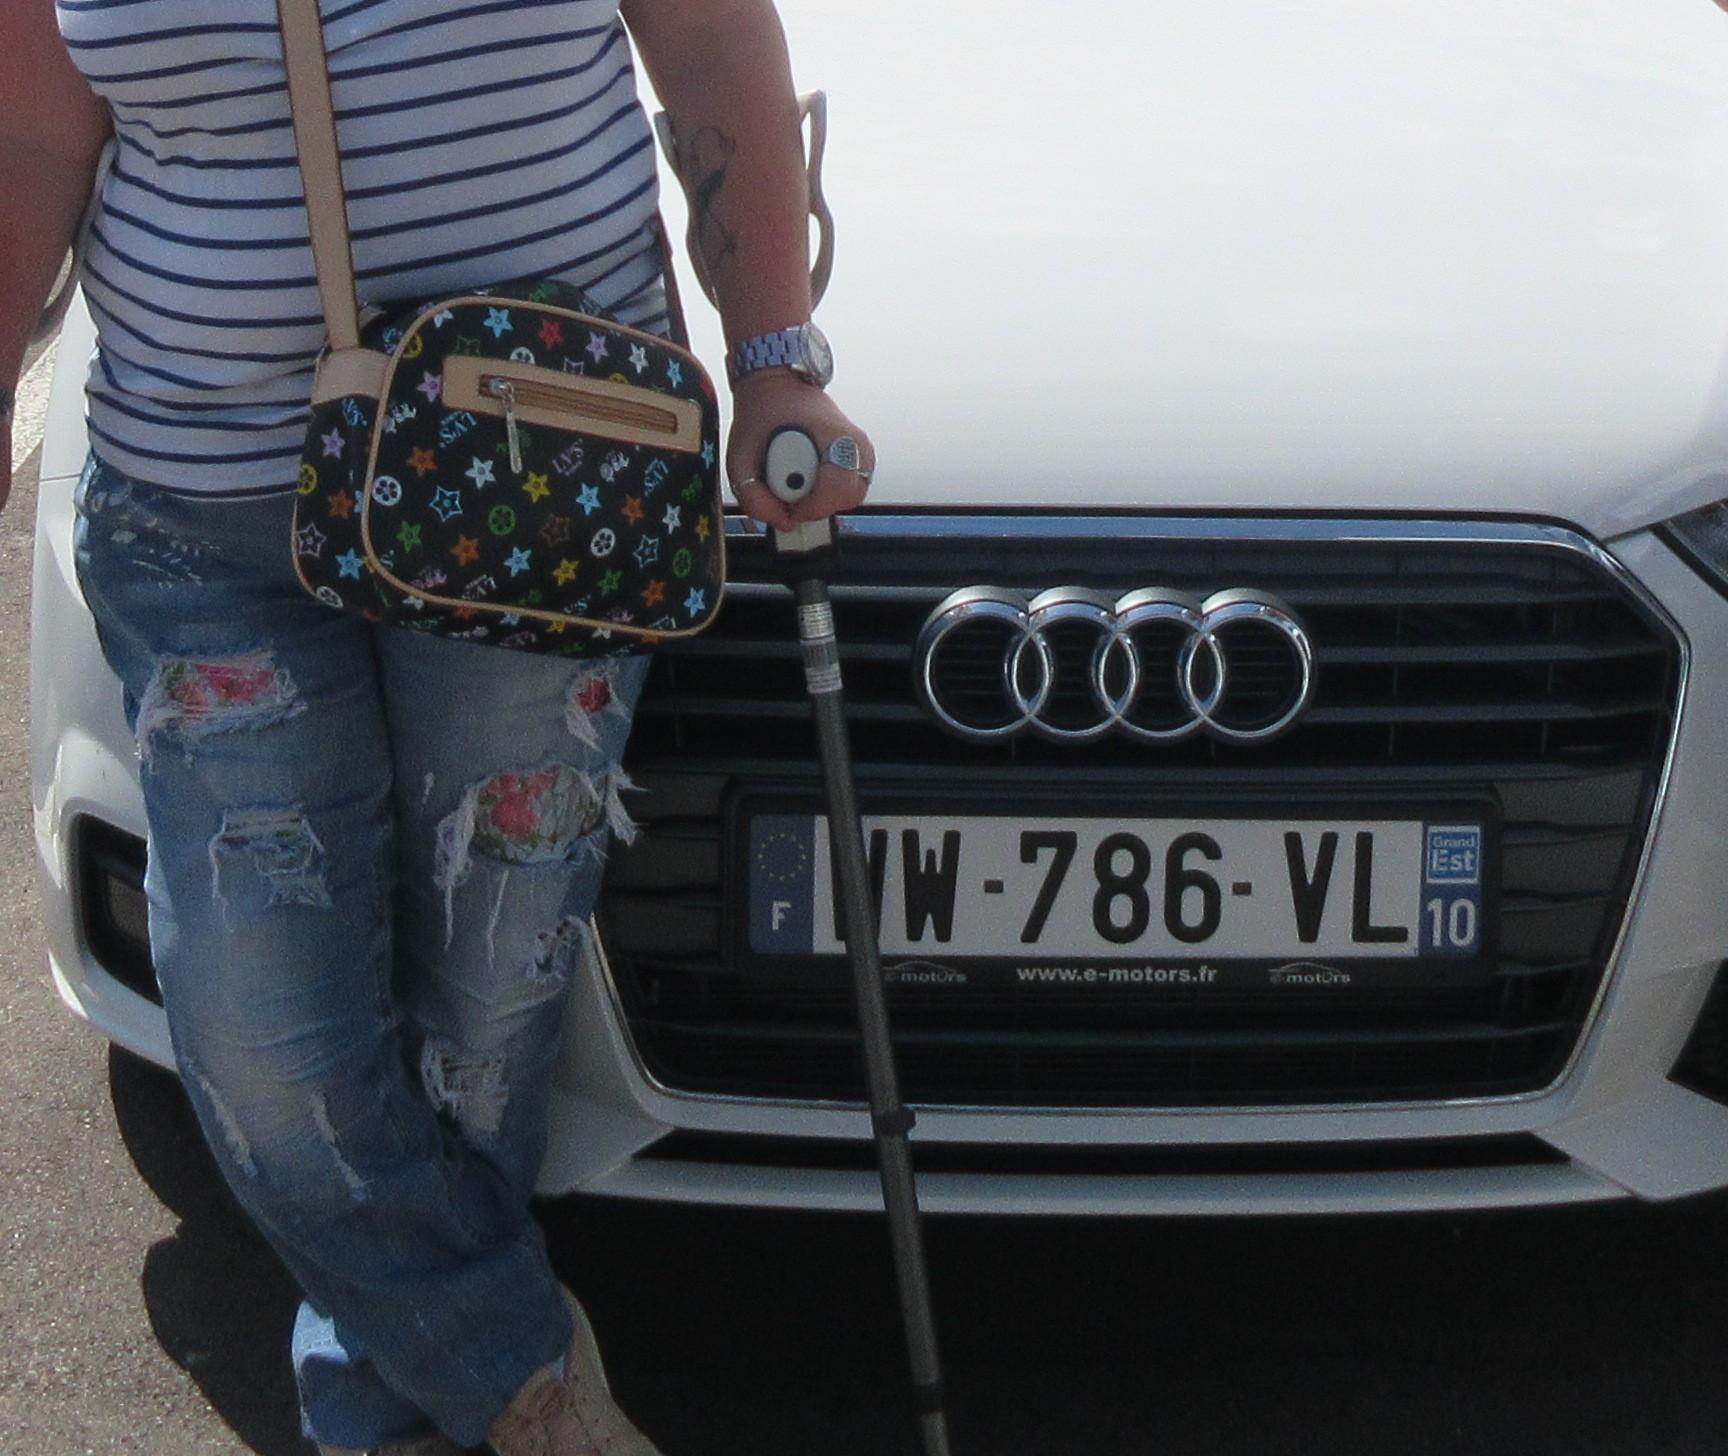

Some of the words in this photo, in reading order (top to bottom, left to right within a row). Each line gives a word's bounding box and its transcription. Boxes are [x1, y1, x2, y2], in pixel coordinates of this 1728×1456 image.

[1432, 835, 1475, 848] Grand
[1431, 849, 1475, 872] Est
[772, 900, 791, 931] F
[1427, 897, 1476, 947] 10
[1016, 965, 1218, 984] www.e-motors.fr
